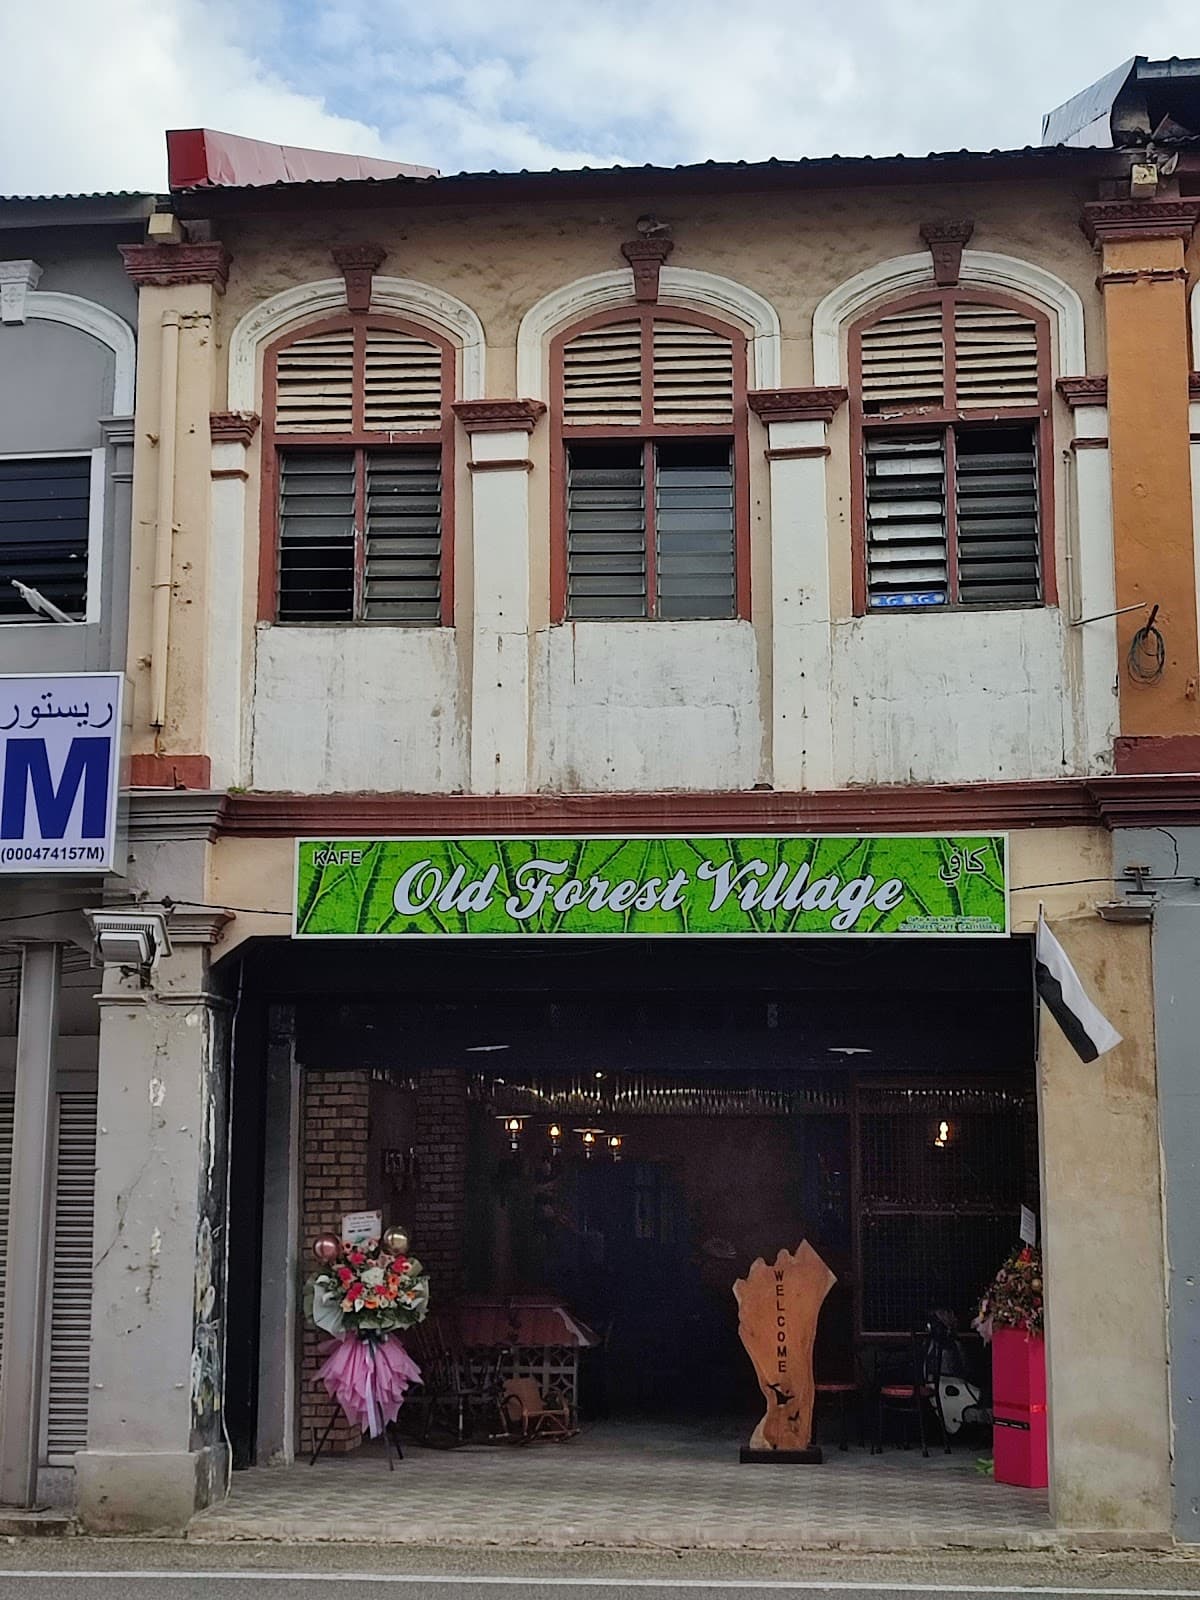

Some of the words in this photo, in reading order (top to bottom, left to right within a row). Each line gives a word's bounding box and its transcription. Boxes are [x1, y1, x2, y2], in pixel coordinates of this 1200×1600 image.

[1, 847, 105, 862] (000474157M)
[313, 850, 362, 866] KAFE
[393, 859, 500, 916] Old
[505, 858, 689, 920] Forest
[696, 858, 905, 931] Village
[774, 1270, 787, 1373] WELCOME
